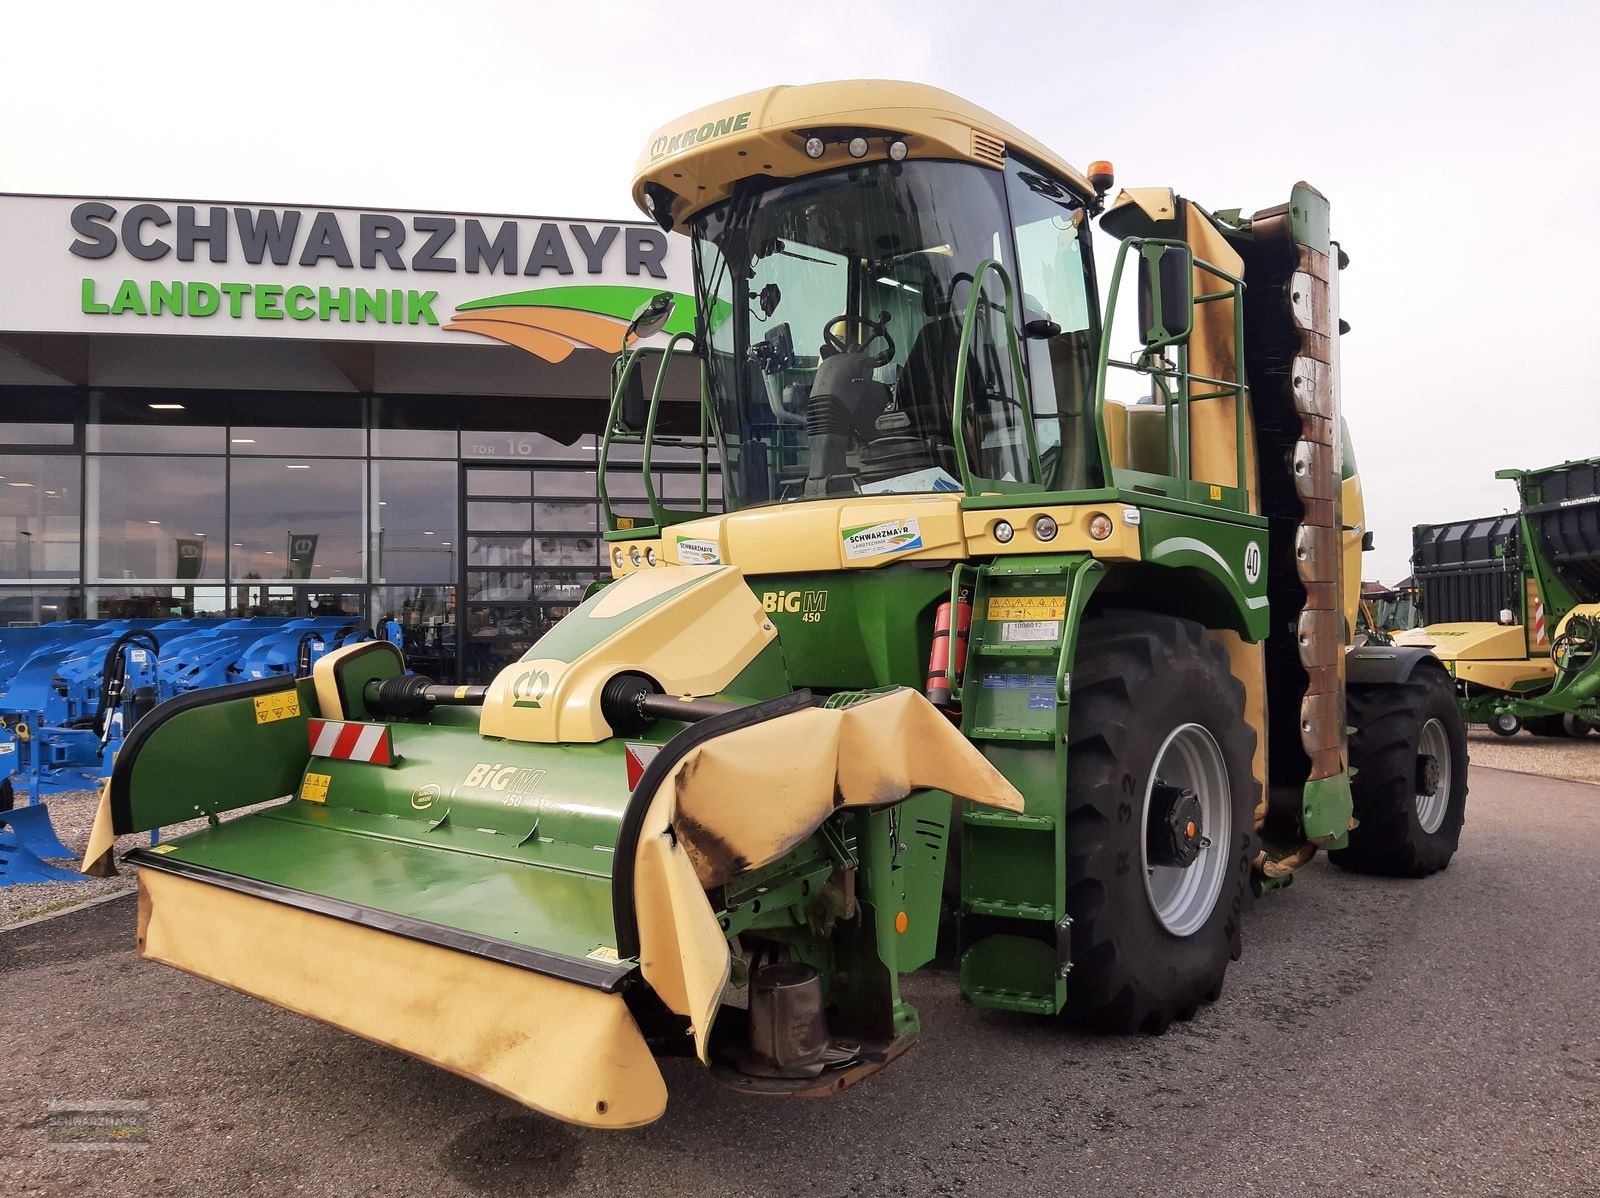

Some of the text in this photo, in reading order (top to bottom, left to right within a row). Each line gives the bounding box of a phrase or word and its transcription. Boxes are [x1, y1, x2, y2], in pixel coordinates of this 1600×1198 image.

[667, 112, 751, 154] KRONE
[69, 202, 668, 279] SCHWARZMAYR
[81, 278, 440, 326] LANDTECHNIK
[472, 438, 532, 455] TOR 16
[849, 526, 909, 543] SCHWARZMAYR
[1246, 548, 1259, 577] 40
[802, 612, 821, 623] 450
[501, 793, 523, 807] 450
